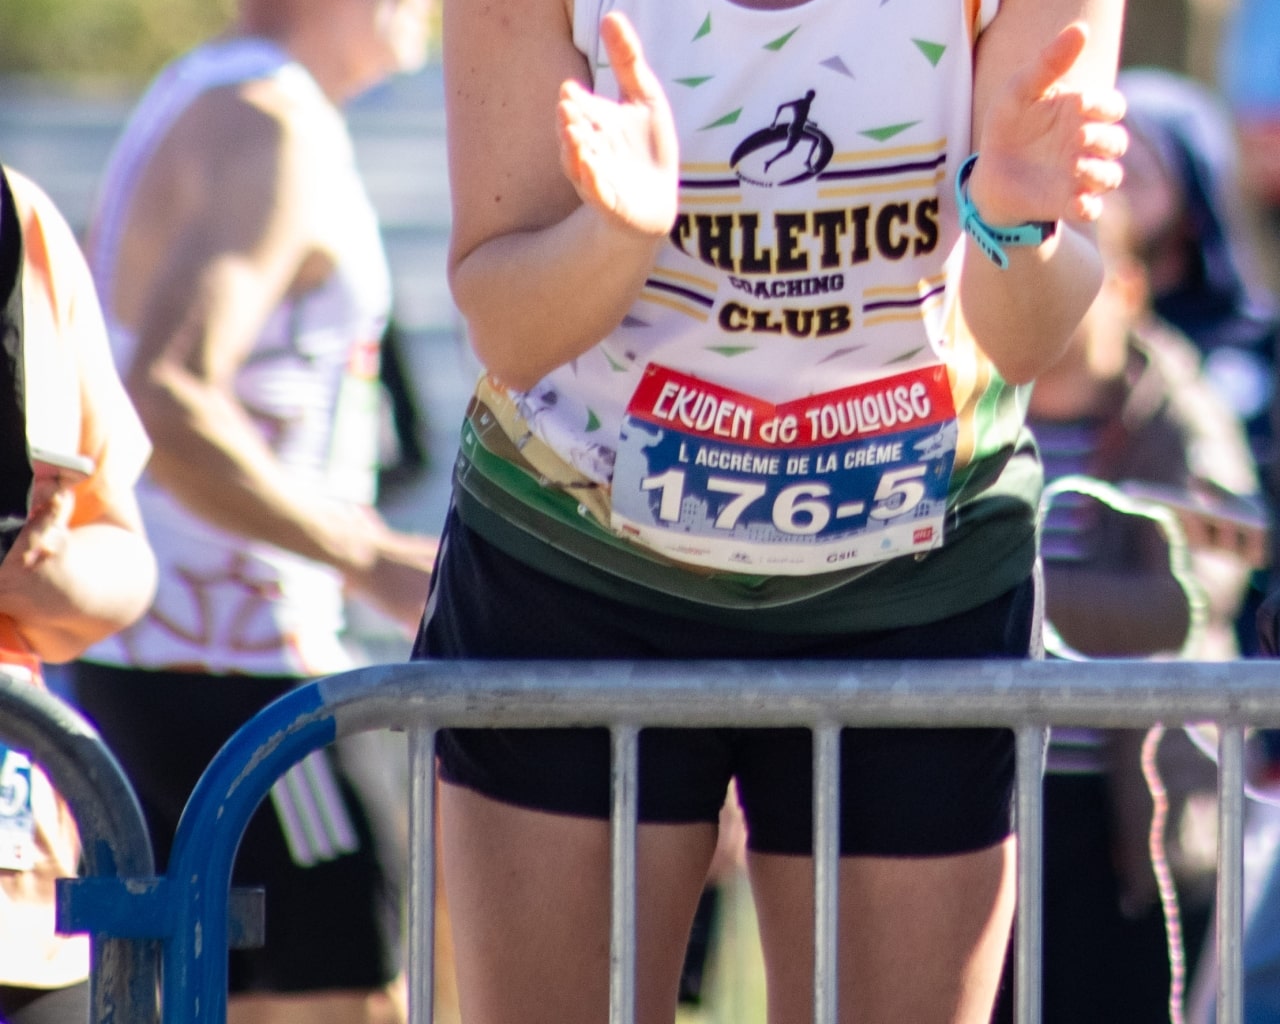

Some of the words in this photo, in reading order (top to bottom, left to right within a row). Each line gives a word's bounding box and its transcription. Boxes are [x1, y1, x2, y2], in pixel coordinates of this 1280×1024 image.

[669, 197, 939, 274] THLETICS
[728, 274, 845, 299] COACHING
[718, 301, 852, 338] CLUB
[652, 381, 753, 440] EKIDEN
[759, 416, 798, 444] de
[786, 456, 809, 475] DE
[815, 452, 838, 473] LA
[641, 465, 927, 536] 176-5
